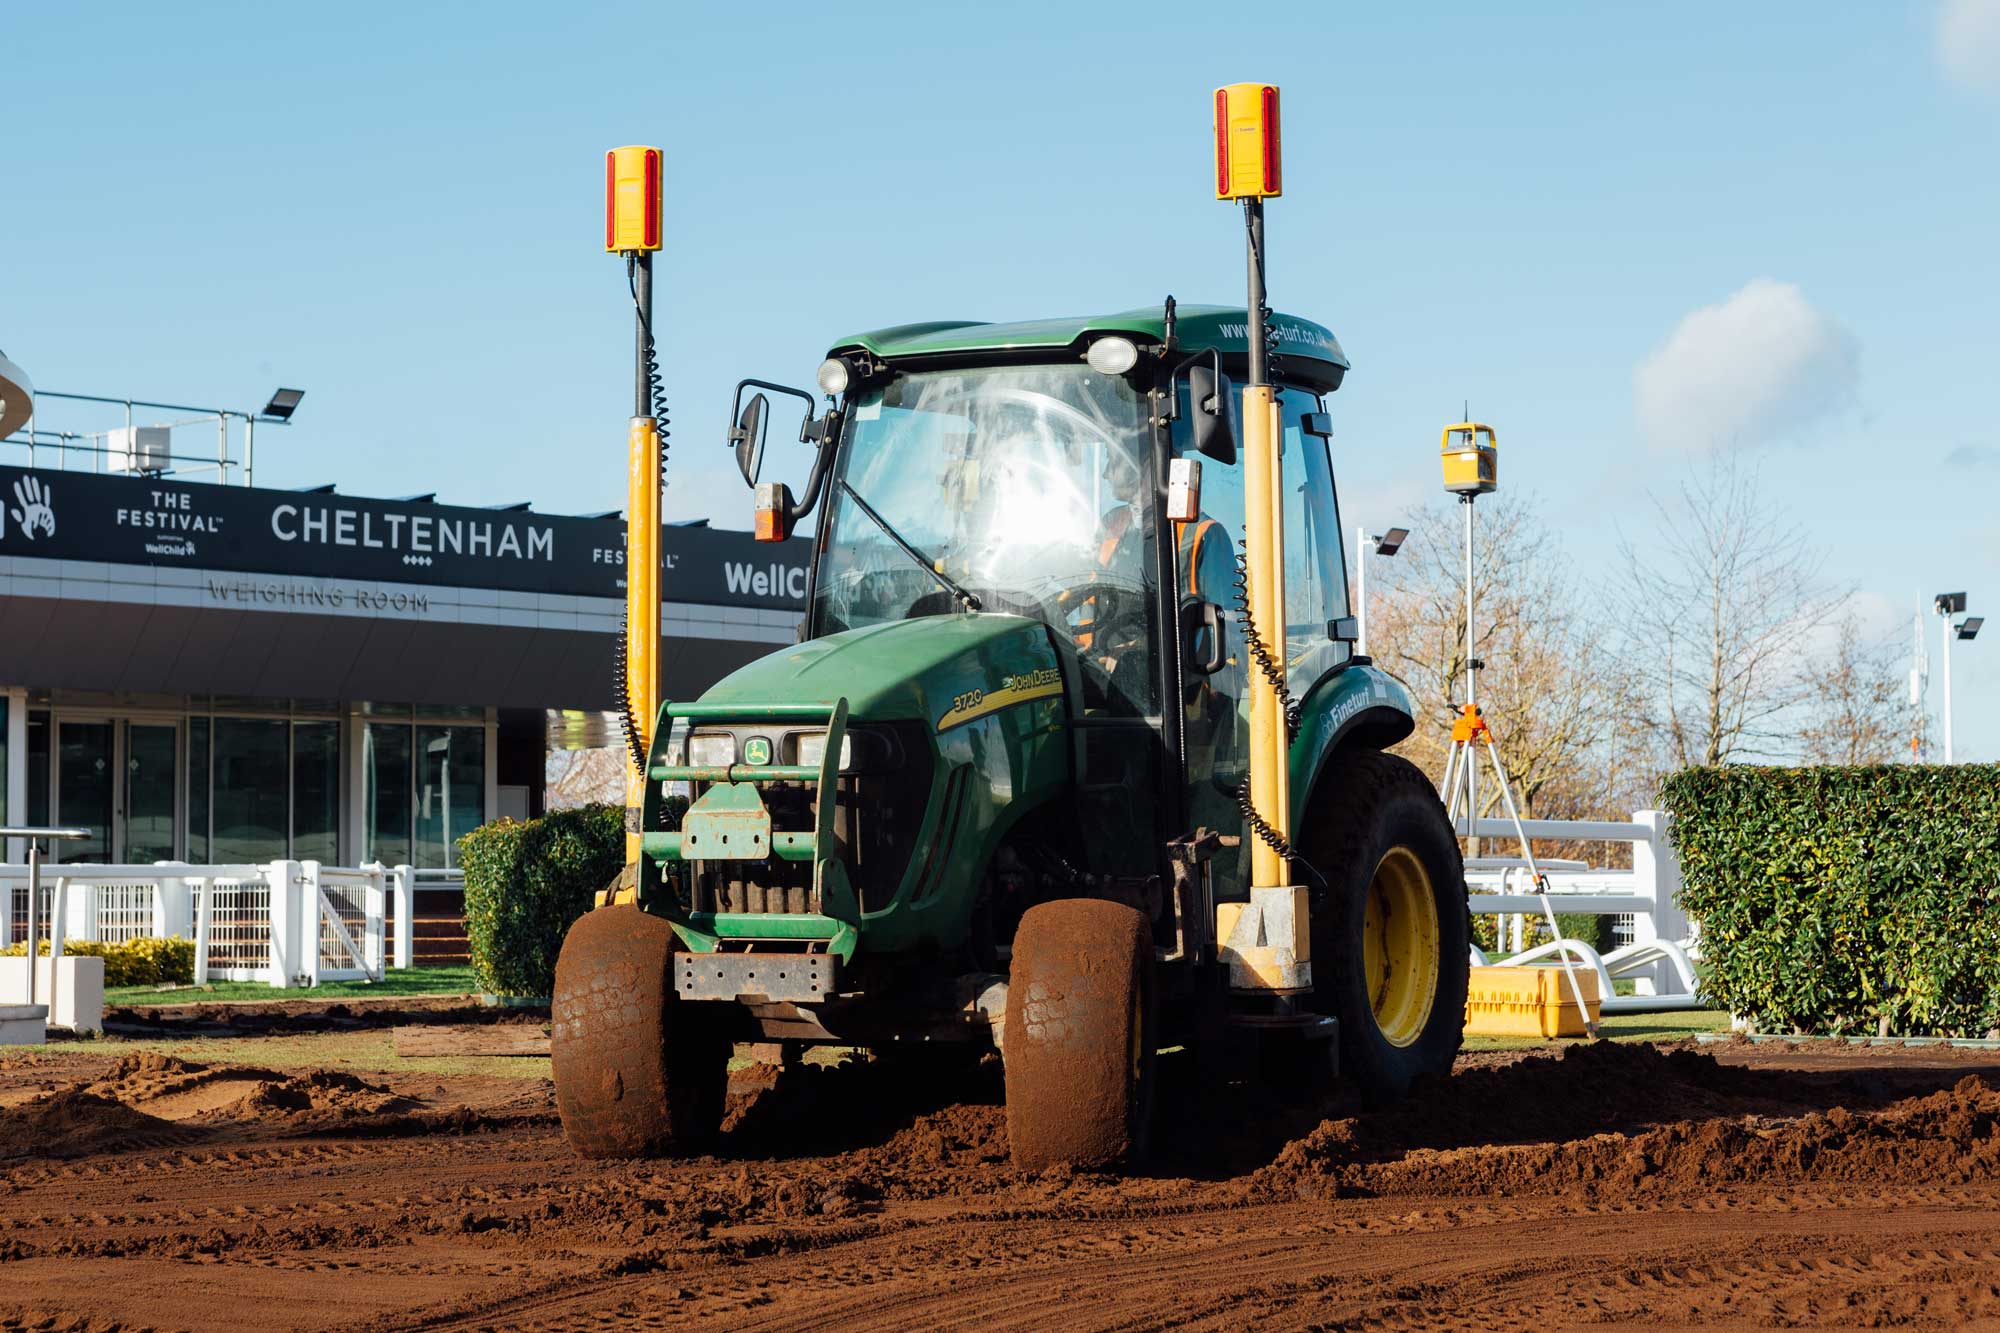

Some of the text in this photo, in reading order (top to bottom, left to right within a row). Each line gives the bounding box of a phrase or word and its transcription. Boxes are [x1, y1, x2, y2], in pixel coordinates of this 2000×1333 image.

[151, 491, 191, 510] THE
[271, 504, 553, 561] CHELTENHAM
[208, 578, 429, 613] WEIGHING ROOM
[724, 561, 809, 599] WellC
[953, 668, 1061, 713] 3720 JOHN DEERE
[1329, 686, 1370, 728] Fineturf
